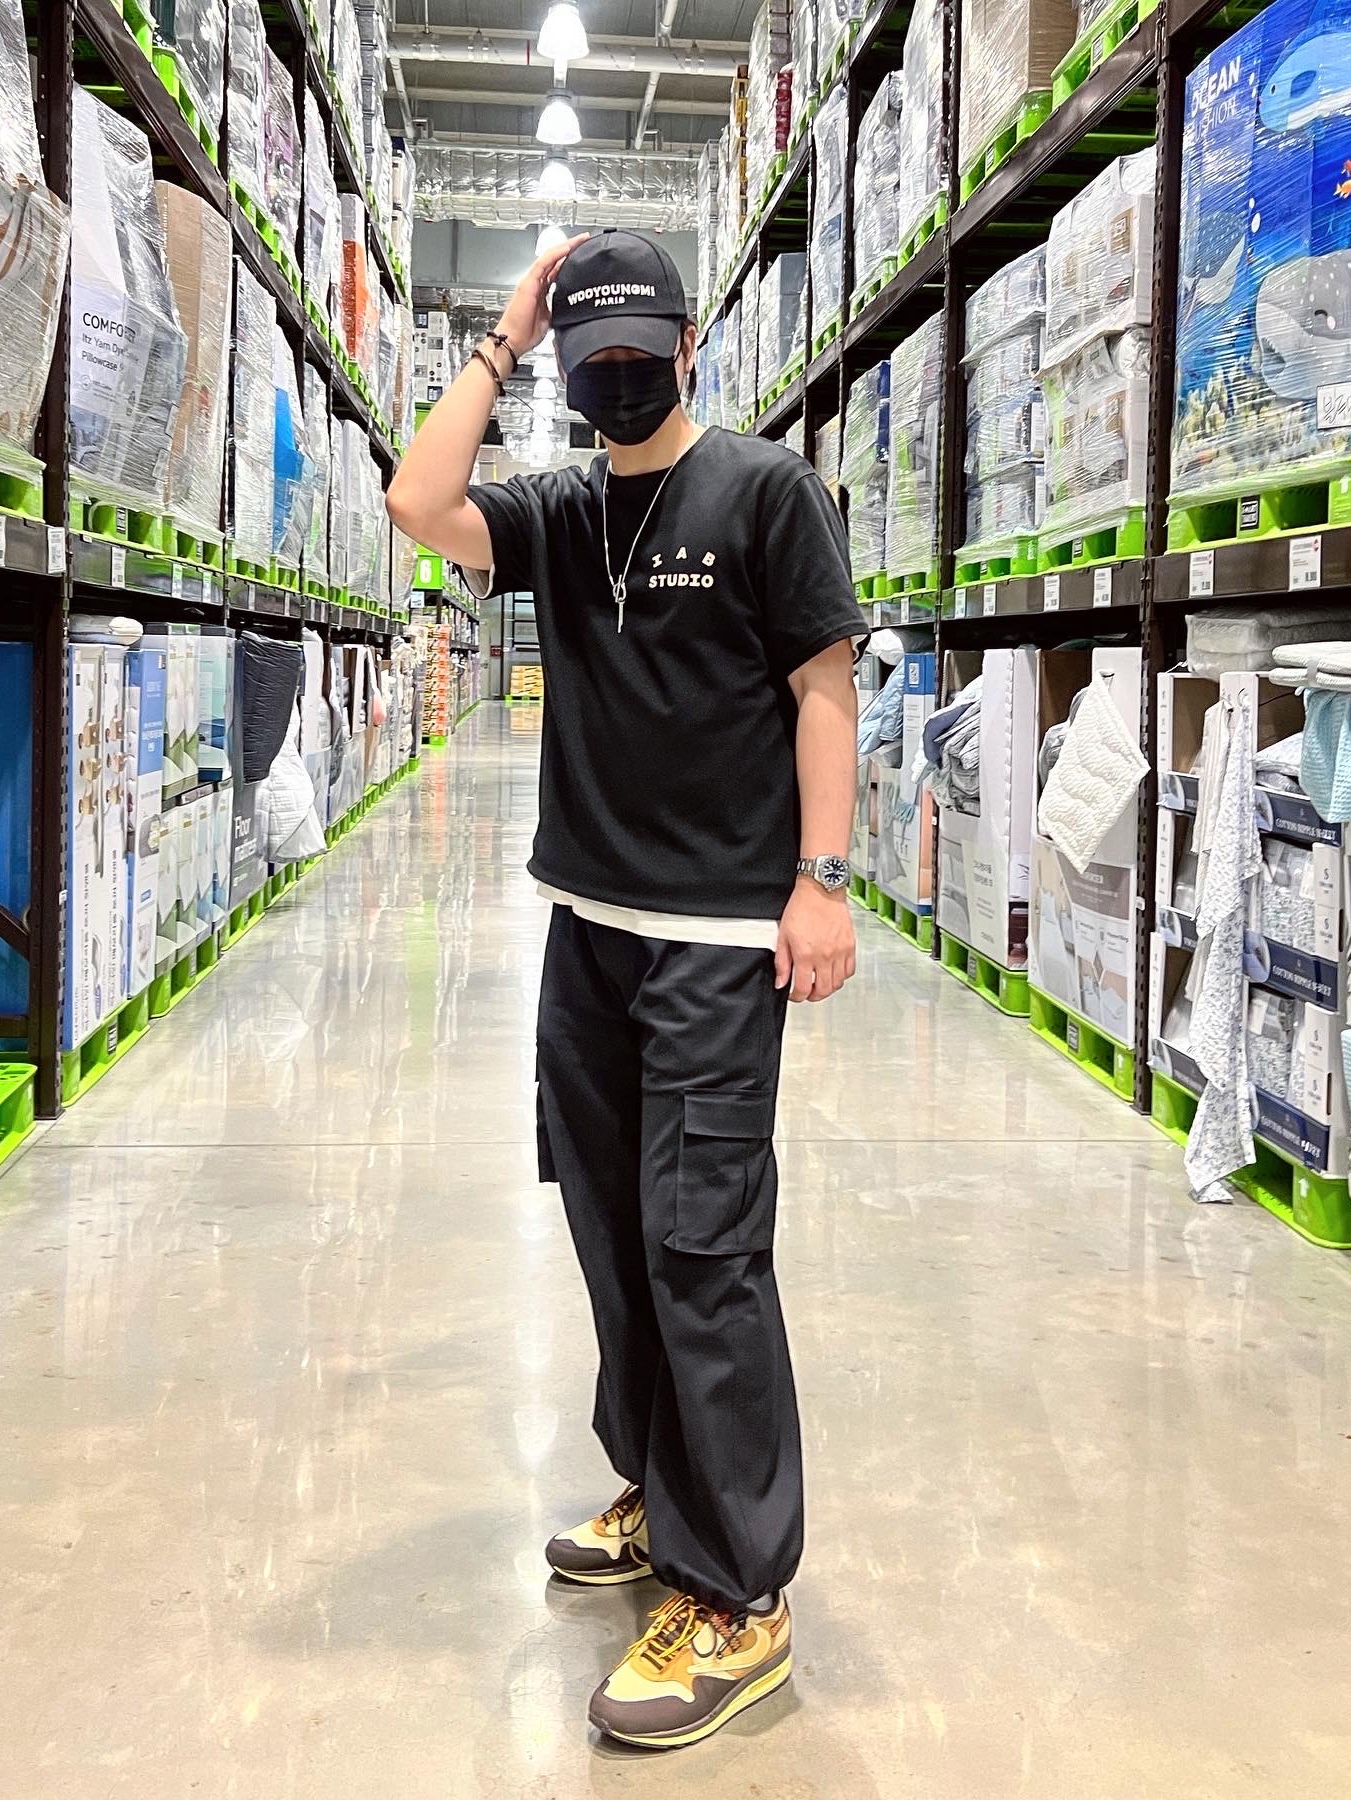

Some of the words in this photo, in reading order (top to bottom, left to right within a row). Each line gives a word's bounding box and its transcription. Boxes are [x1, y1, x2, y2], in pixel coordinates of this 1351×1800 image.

[1191, 56, 1241, 118] OCEAN
[567, 284, 655, 306] WOOYOUNGMI
[594, 296, 626, 308] PARIS
[82, 312, 136, 344] COMFO
[420, 559, 433, 584] 6
[648, 573, 714, 589] STUDIO
